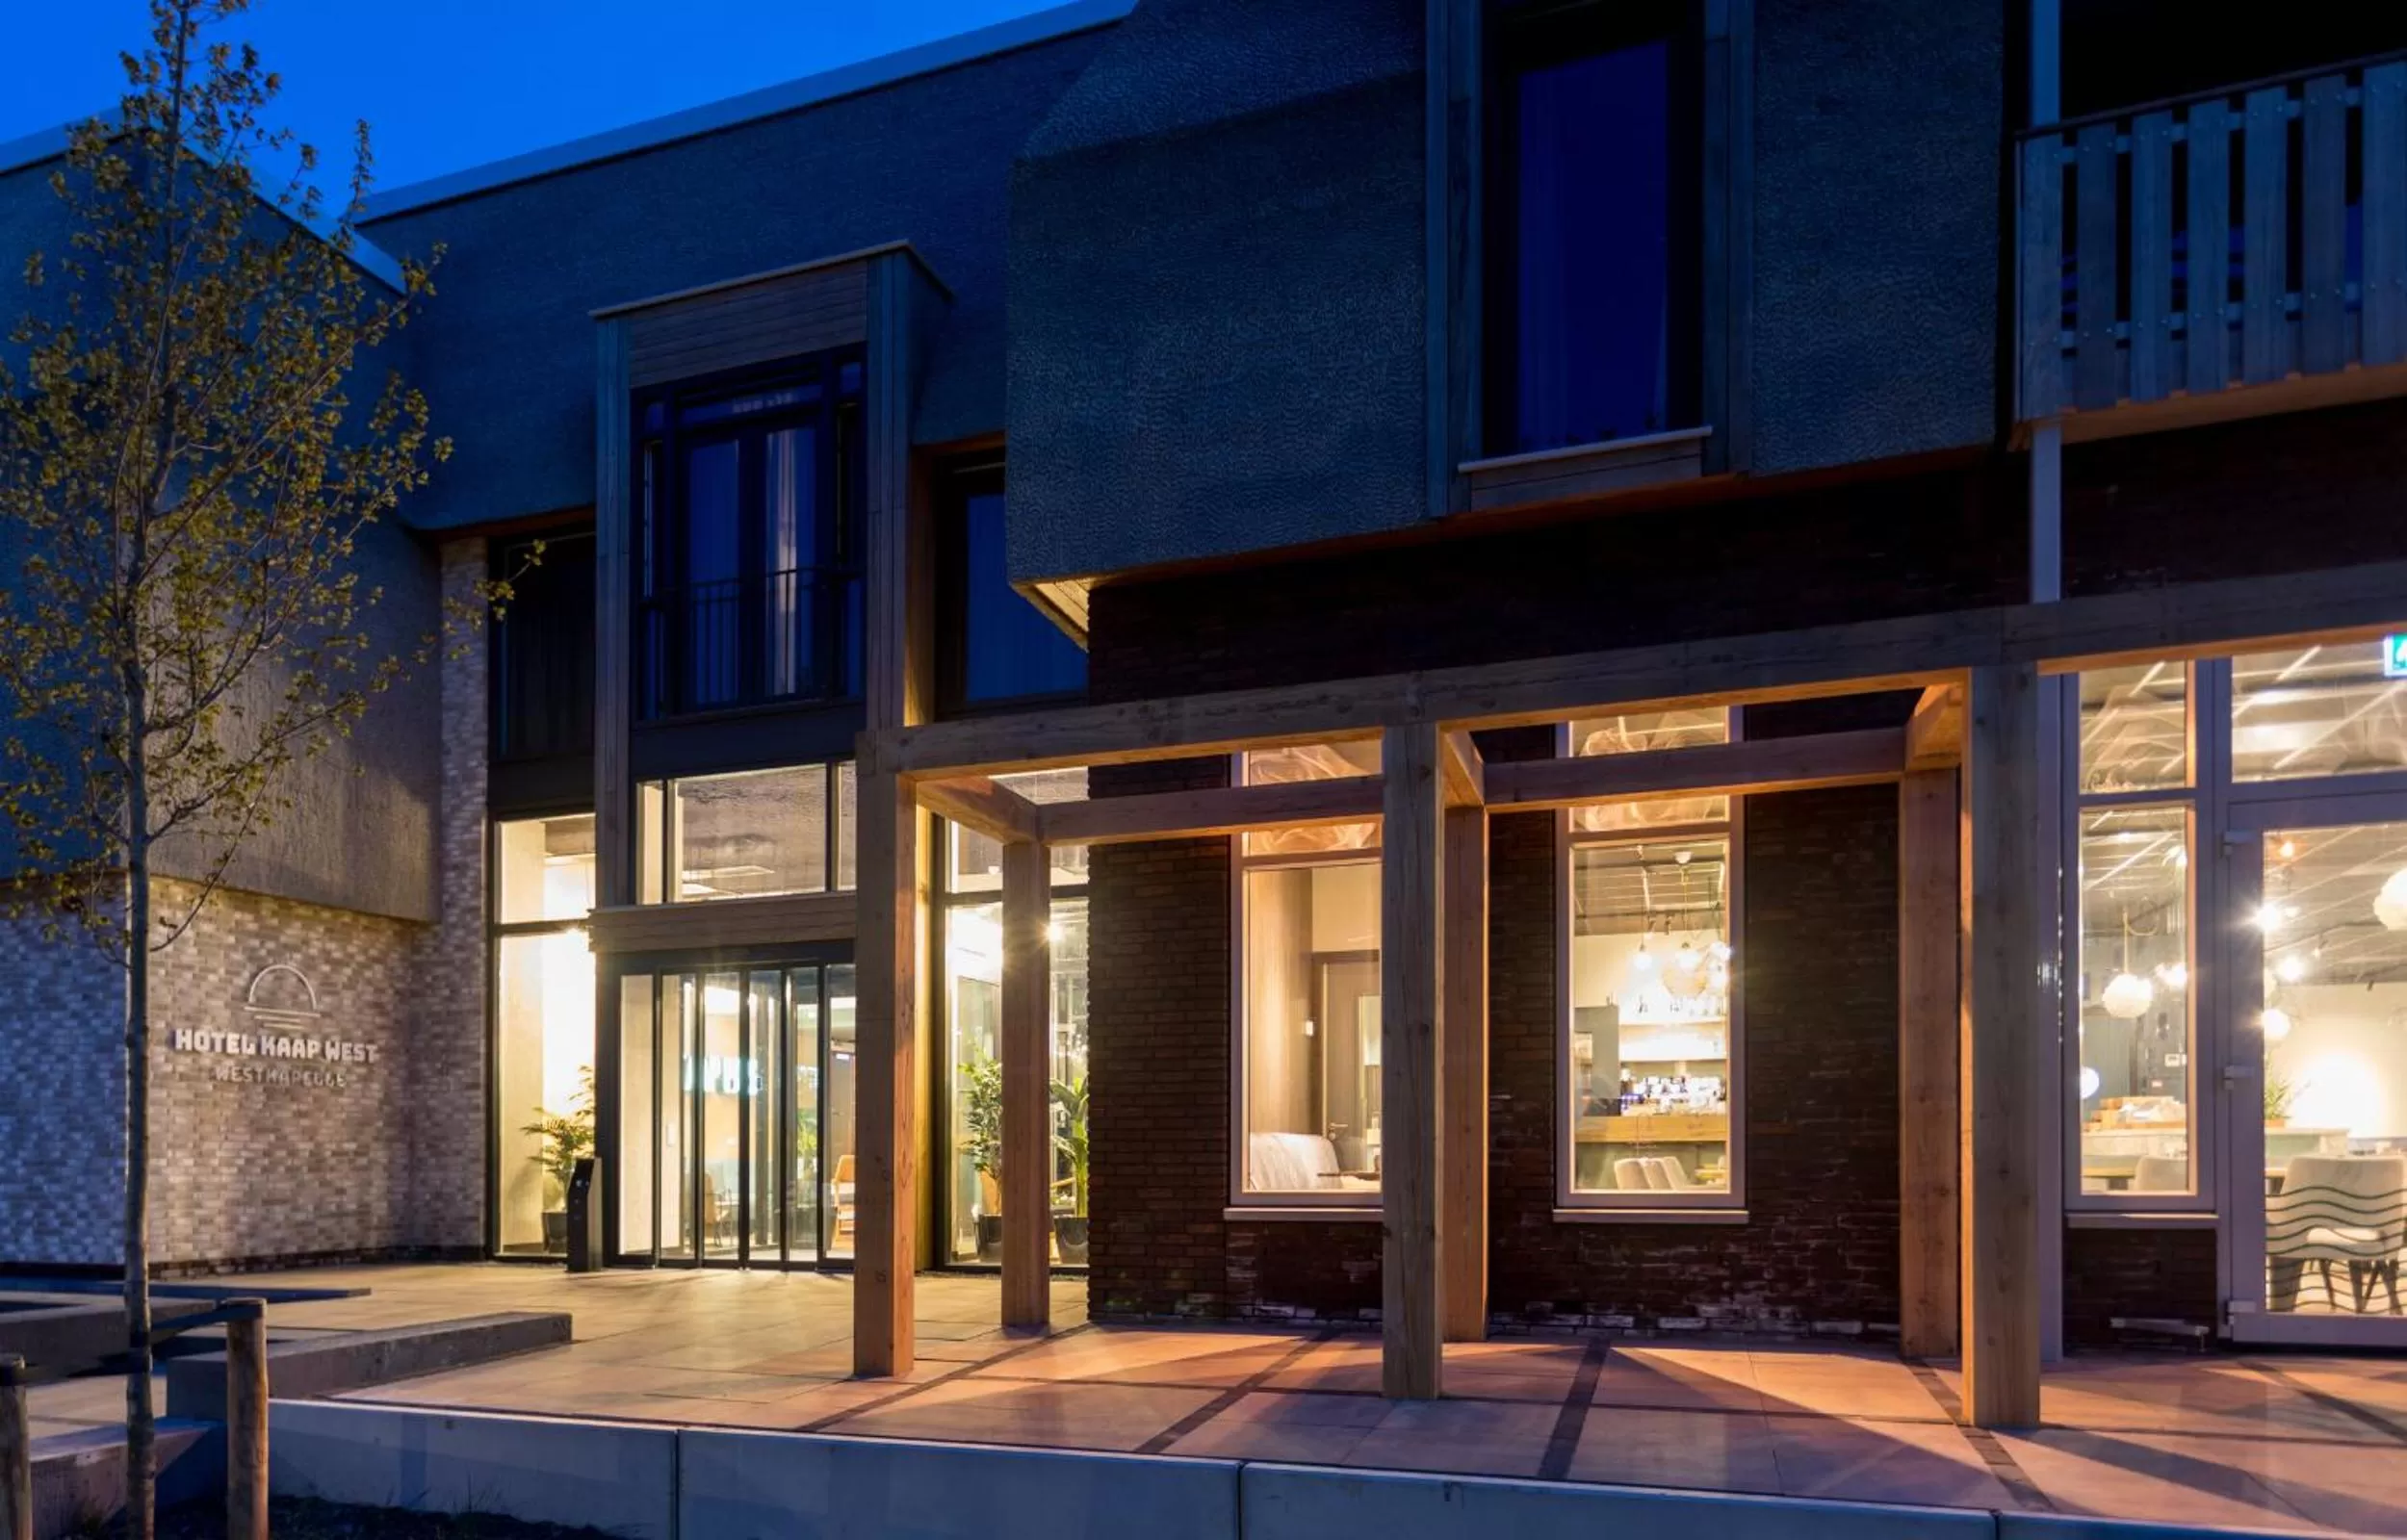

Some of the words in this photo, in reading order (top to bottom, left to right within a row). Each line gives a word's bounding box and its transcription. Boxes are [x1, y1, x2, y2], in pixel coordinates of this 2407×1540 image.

[175, 1028, 256, 1056] HOTEL
[260, 1035, 322, 1060] KAAP
[324, 1040, 378, 1064] WEST
